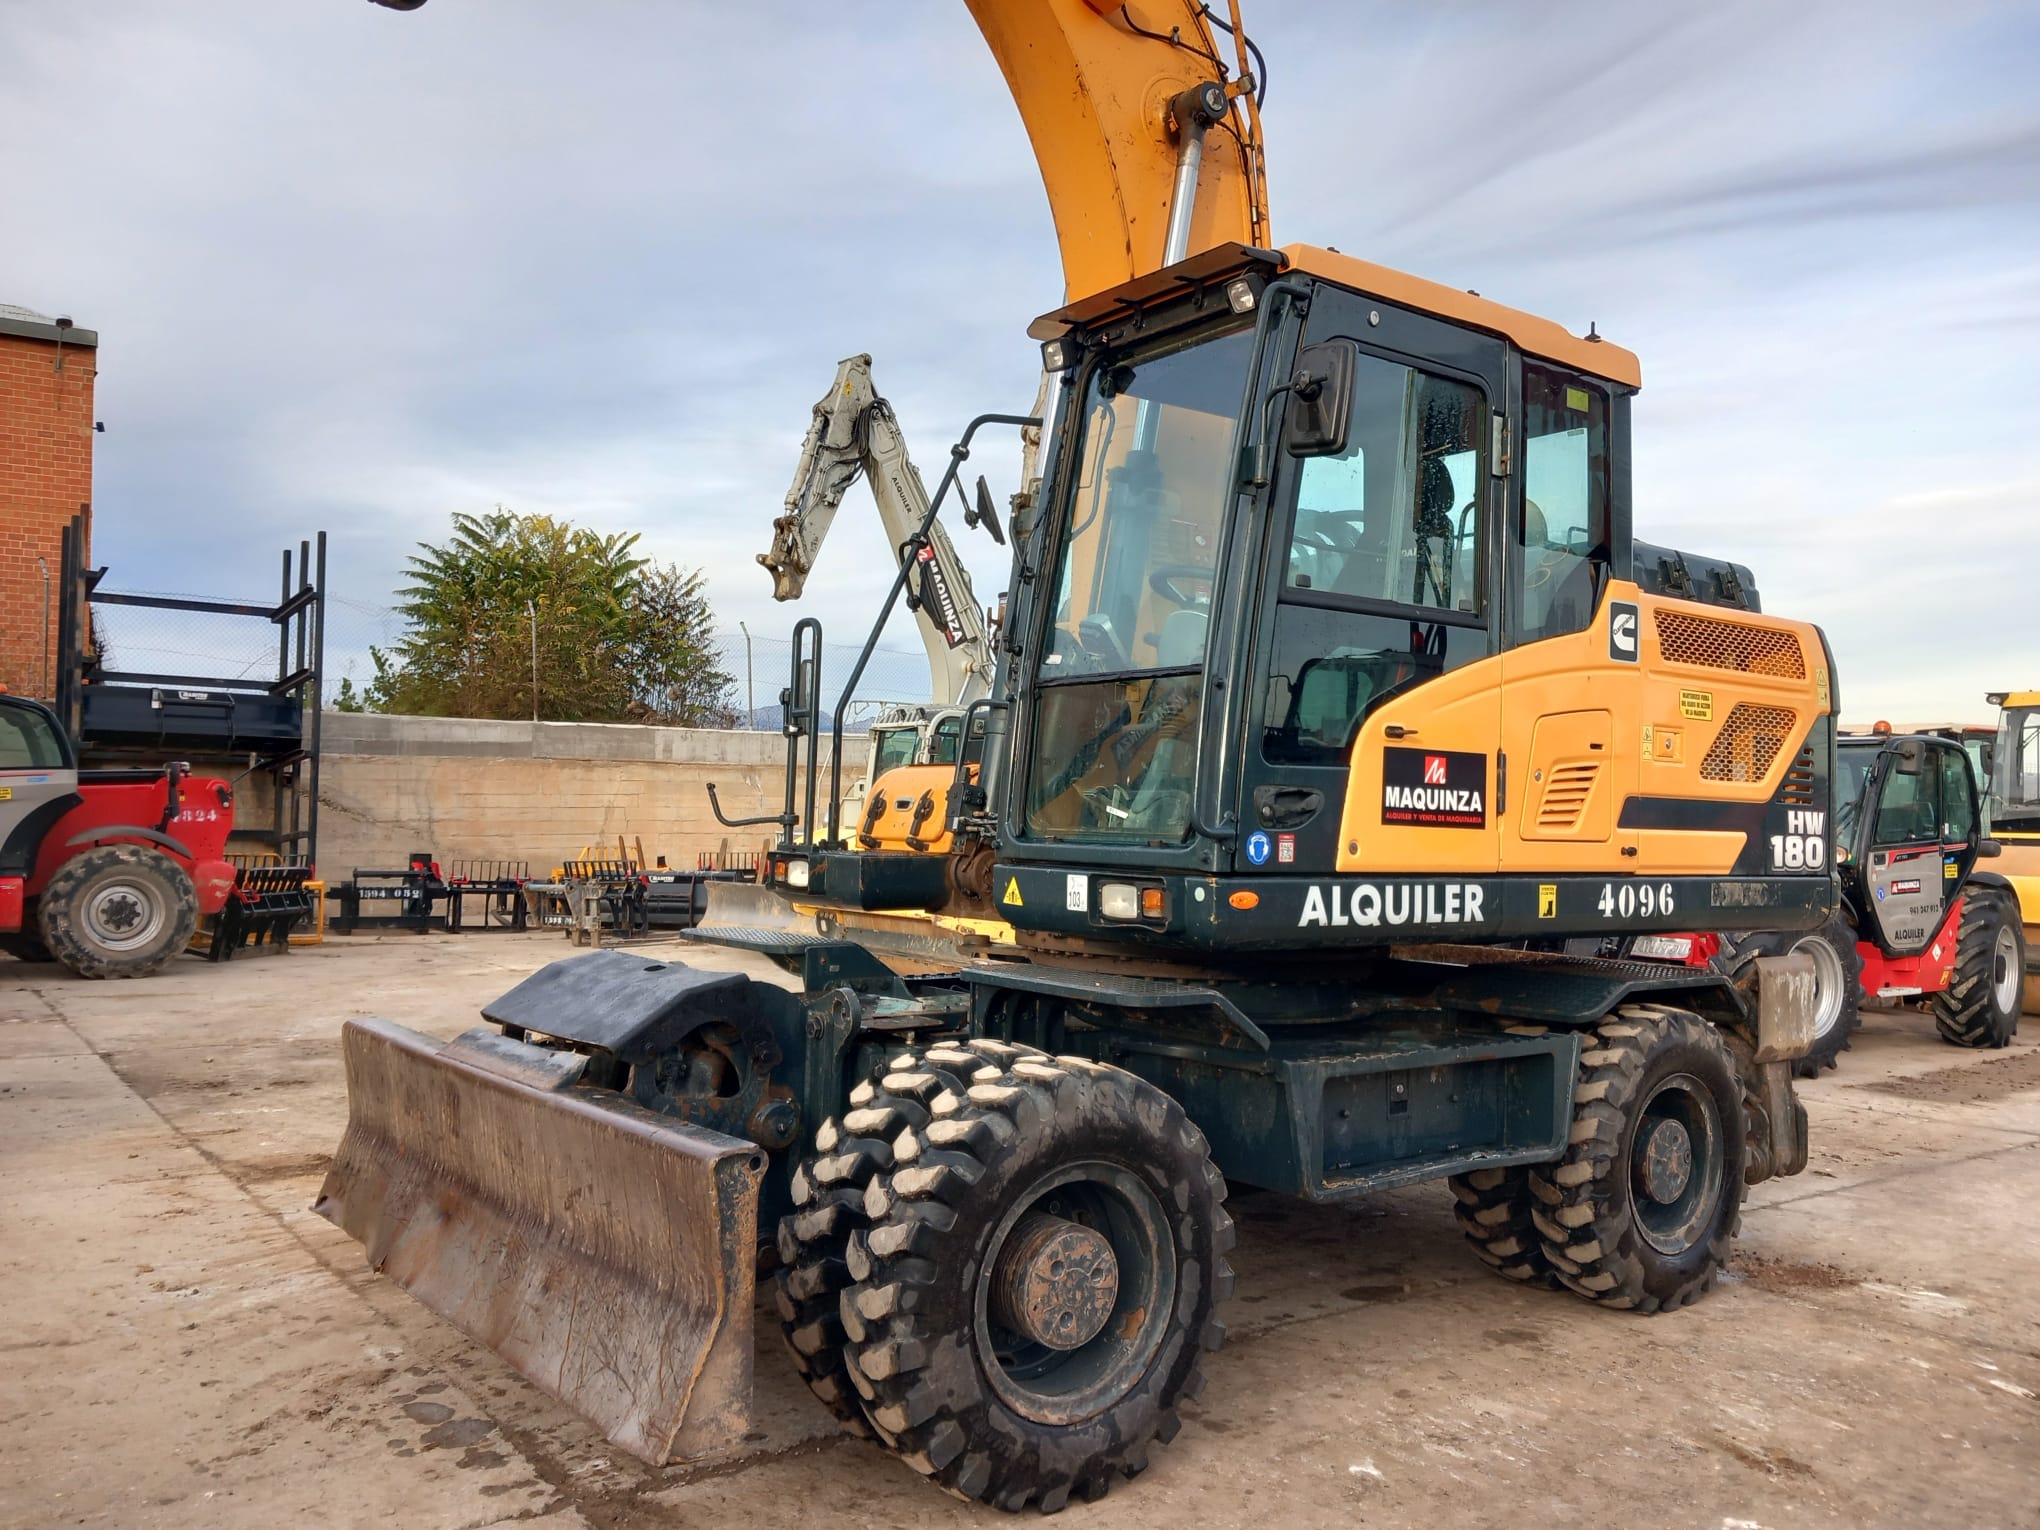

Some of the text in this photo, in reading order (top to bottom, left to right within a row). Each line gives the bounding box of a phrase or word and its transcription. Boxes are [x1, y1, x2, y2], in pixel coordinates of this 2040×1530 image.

[891, 477, 912, 514] ALQUILER
[929, 560, 963, 643] MAQUINZA
[1613, 615, 1633, 636] Cummins
[1385, 785, 1482, 812] MAQUINZA
[172, 808, 218, 823] 824
[1385, 811, 1412, 820] ALQUILER
[1418, 813, 1437, 822] VENTA
[1446, 815, 1482, 824] MAQUINARIA
[1787, 810, 1825, 835] HW
[1770, 835, 1825, 870] 180
[1068, 891, 1081, 908] 103
[1297, 883, 1485, 928] ALQUILER
[1598, 882, 1674, 918] 4096
[1895, 928, 1925, 940] ALQUILER
